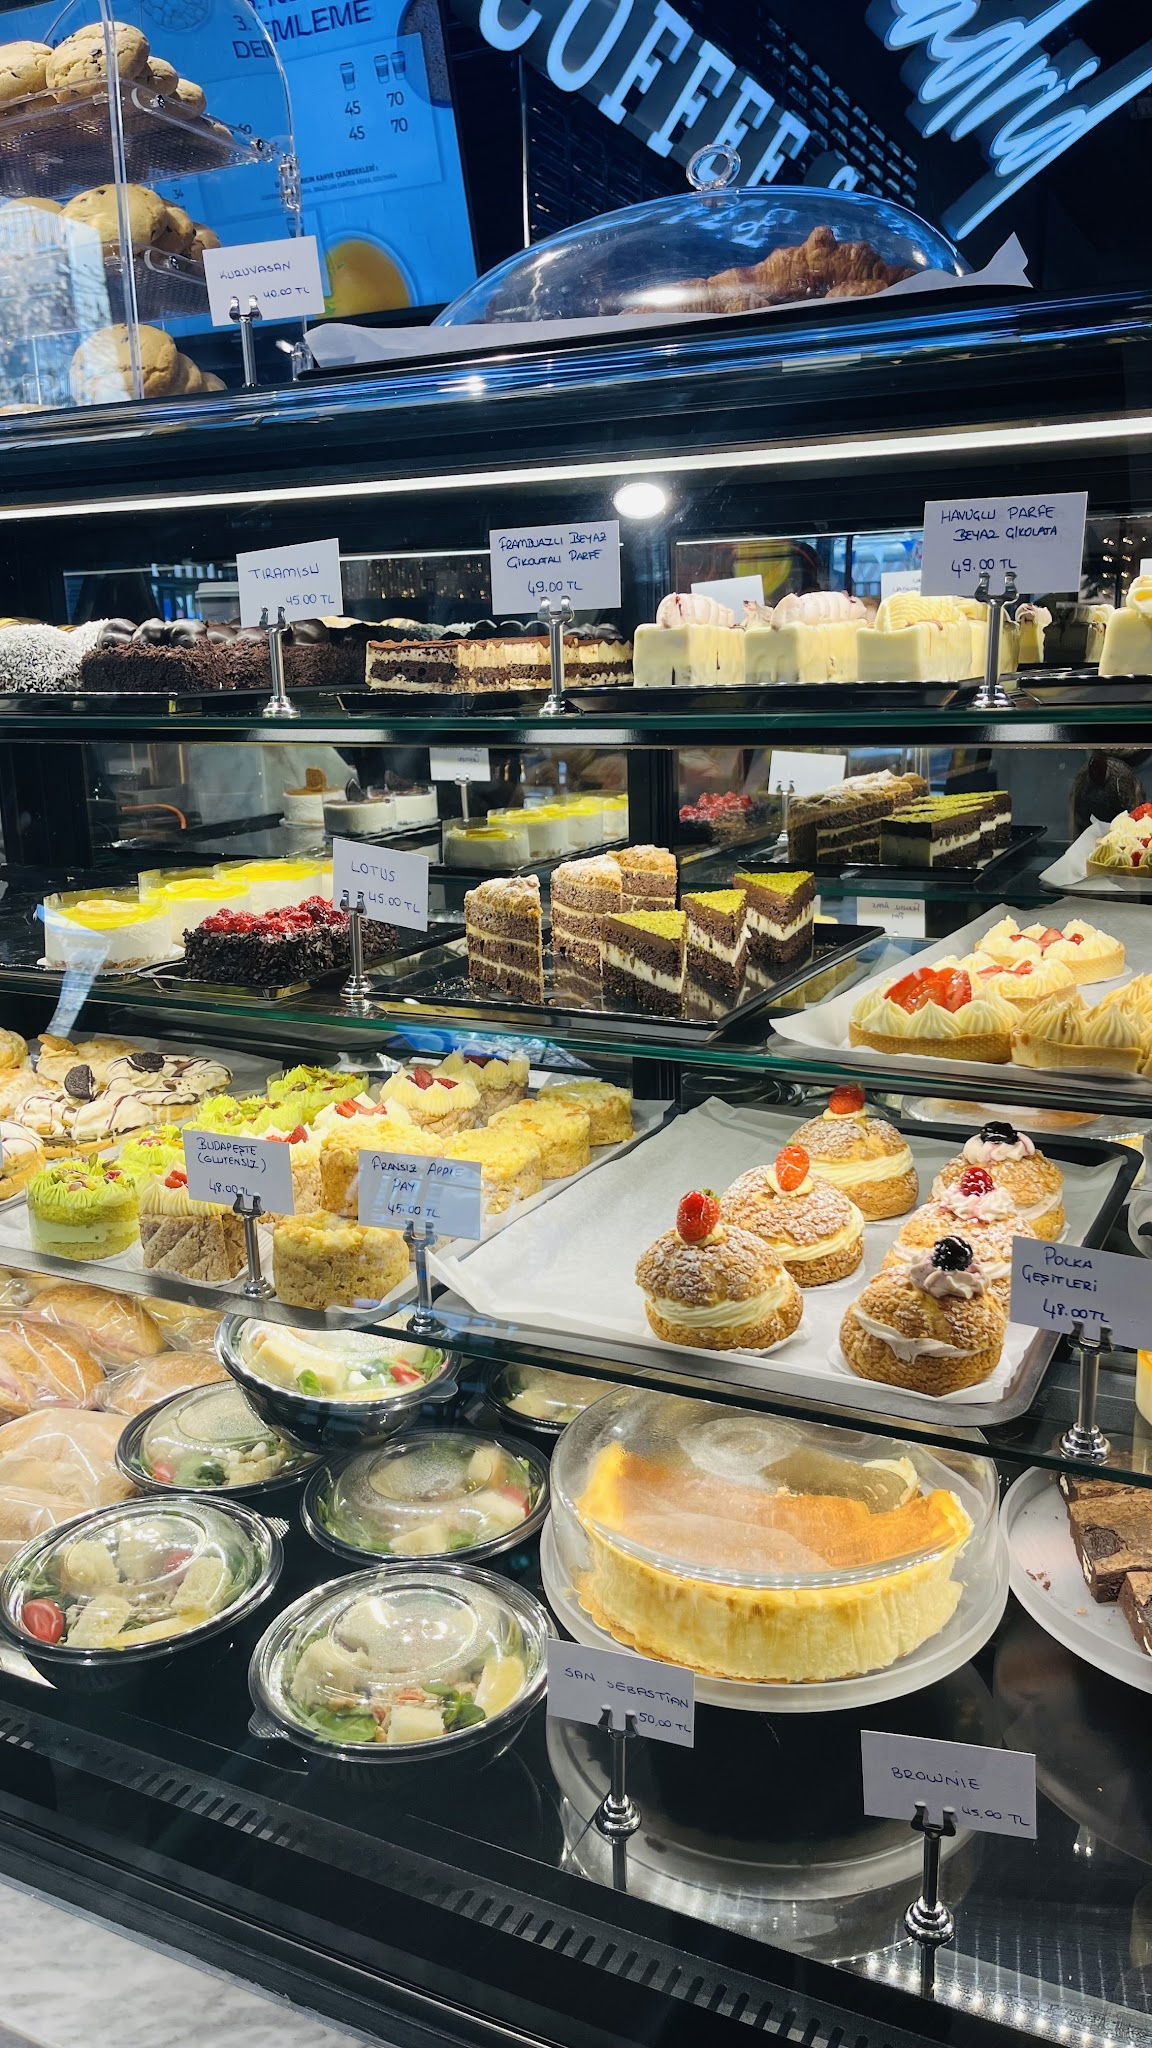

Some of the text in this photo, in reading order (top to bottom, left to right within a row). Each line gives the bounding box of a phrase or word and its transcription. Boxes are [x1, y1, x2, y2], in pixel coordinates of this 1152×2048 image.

[345, 91, 405, 116] 45 70
[349, 117, 409, 141] 45 70
[220, 261, 291, 279] KURUVASAN
[263, 286, 310, 298] 40.00 TL
[1007, 504, 1057, 520] PARFE
[567, 531, 607, 545] BEYAZ
[953, 528, 1000, 542] BEYAZ
[567, 549, 603, 562] PARFE
[248, 563, 320, 580] TIRAMISU
[951, 558, 1018, 579] 49.00 TL
[527, 580, 584, 597] 49.00 TL
[319, 594, 335, 604] TL
[351, 860, 396, 882] LOTUS
[368, 890, 421, 914] 45.00 TL
[391, 1177, 416, 1193] PAY
[387, 1202, 441, 1218] 45.00 TL
[1043, 1245, 1094, 1270] POLKA
[564, 1666, 597, 1682] SAN
[674, 1722, 692, 1734] TL
[1007, 1812, 1031, 1827] TL
